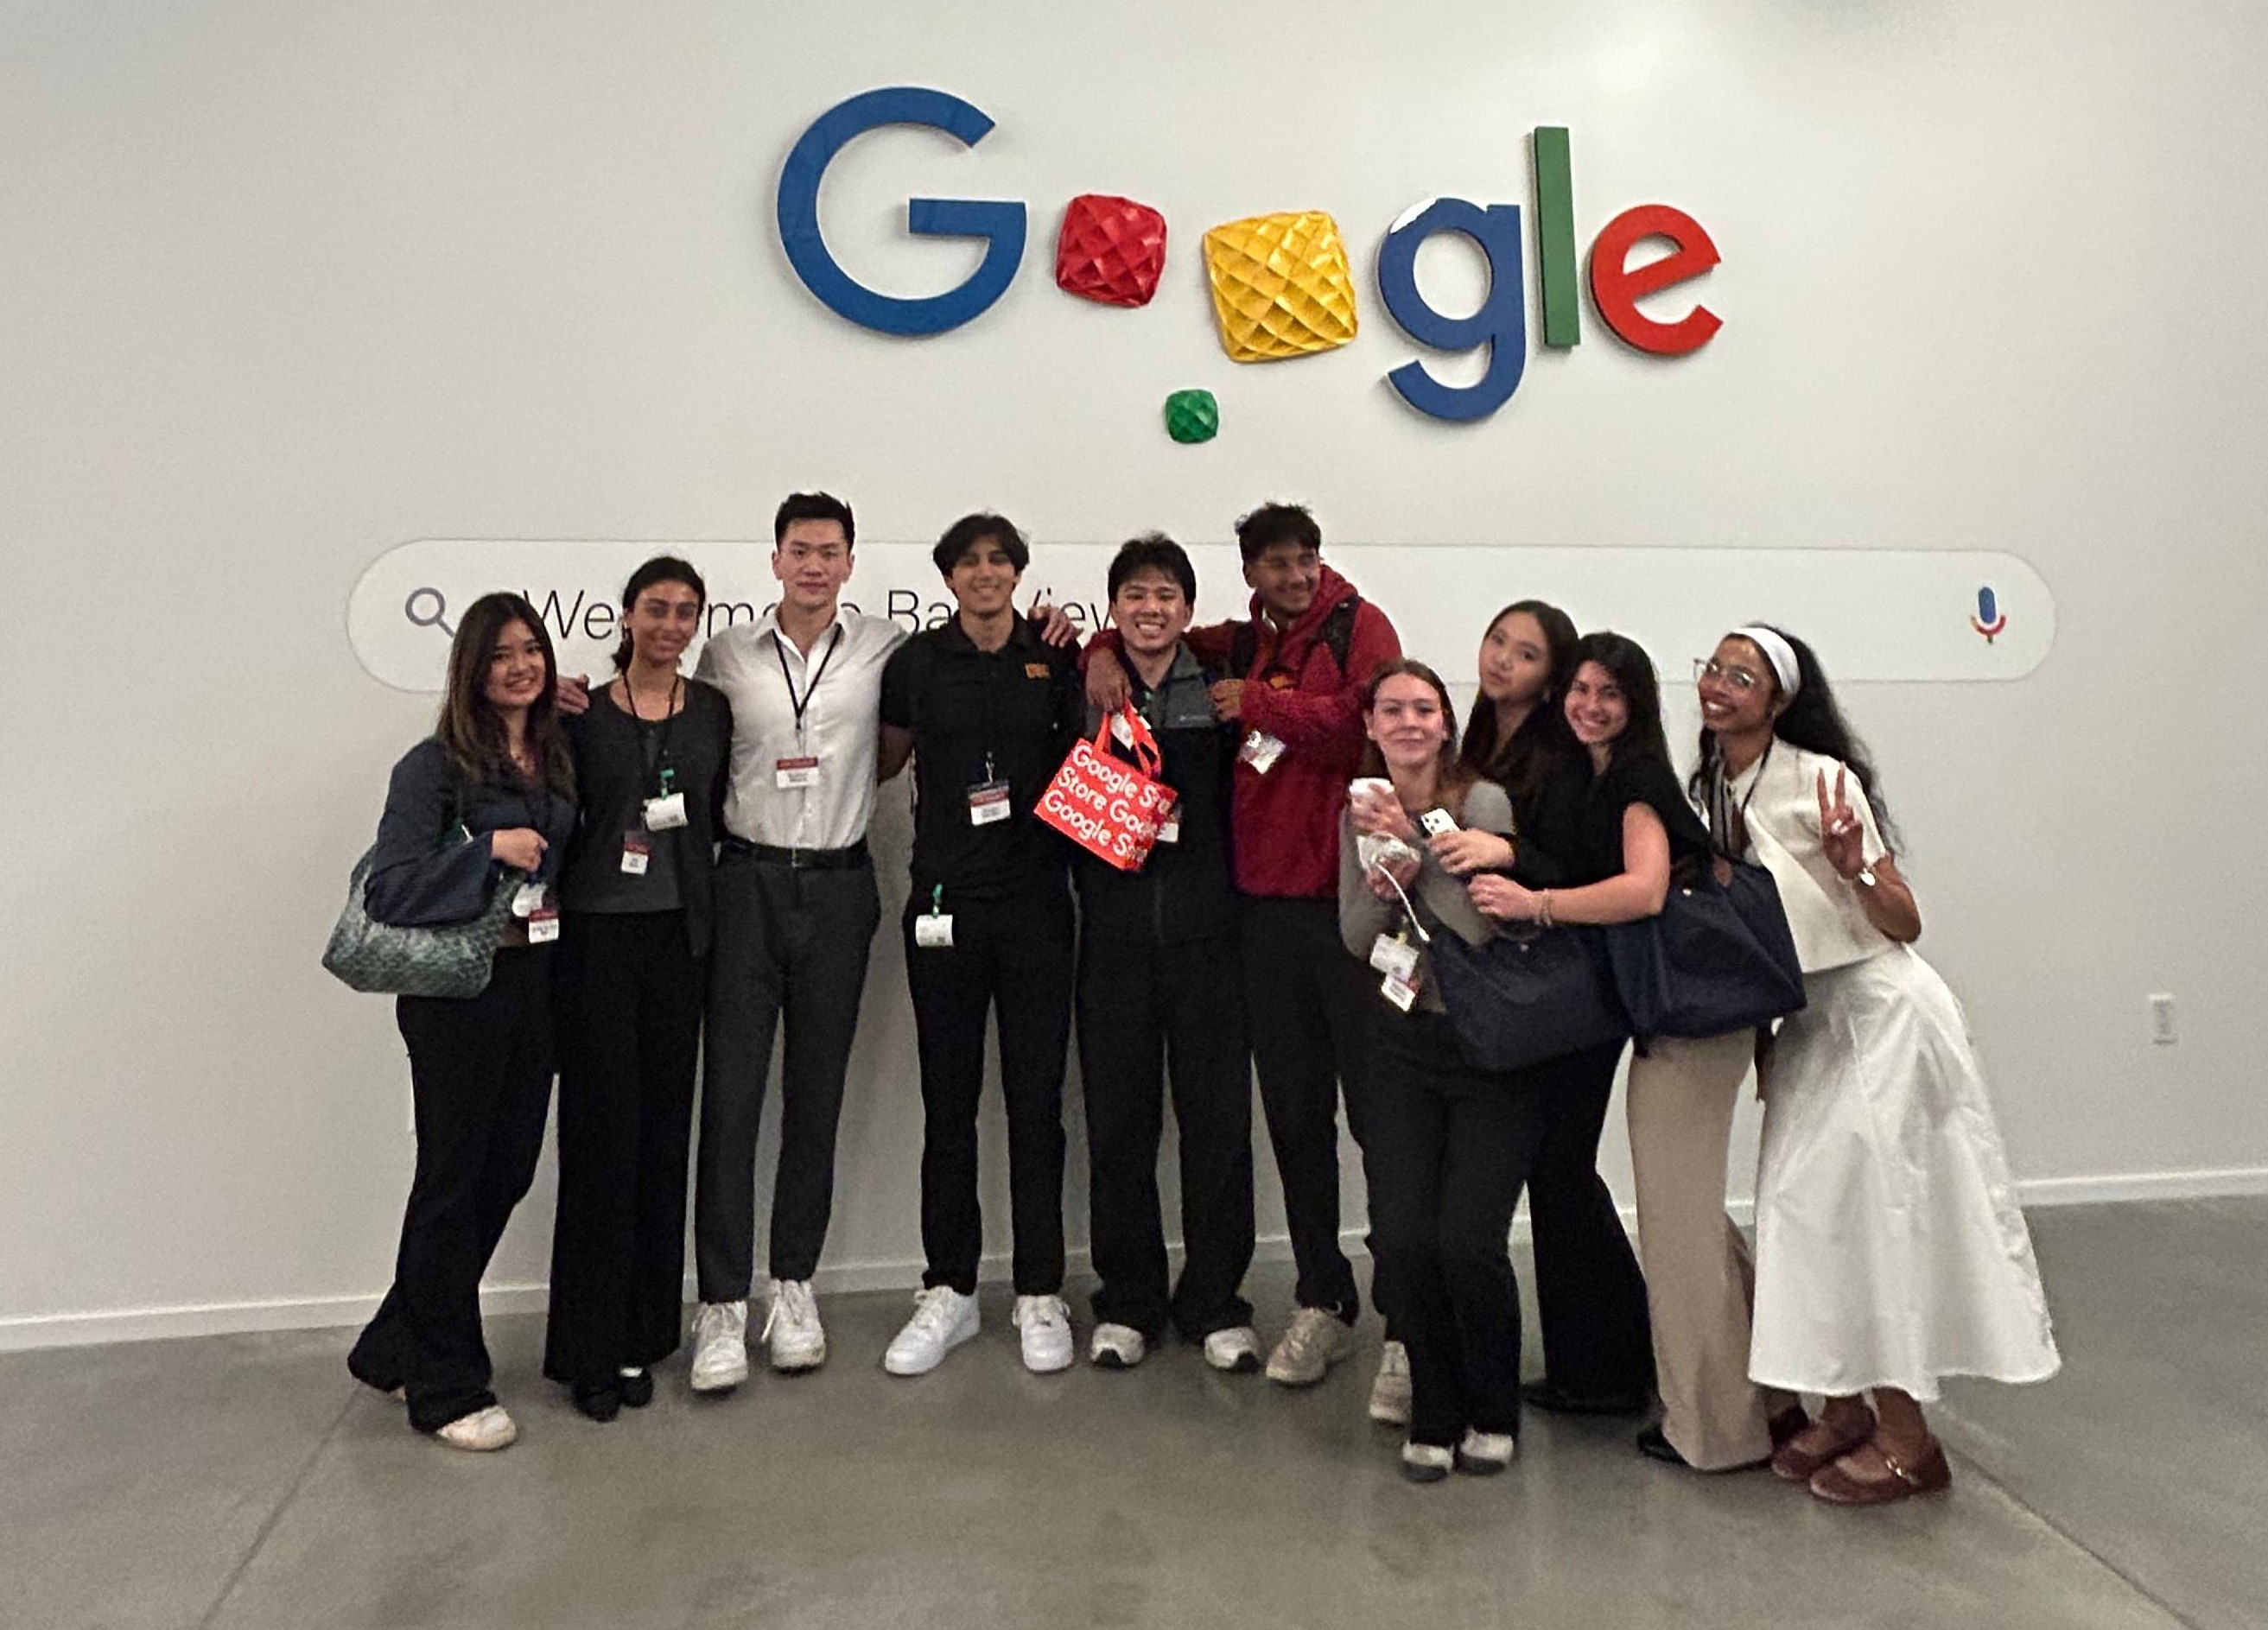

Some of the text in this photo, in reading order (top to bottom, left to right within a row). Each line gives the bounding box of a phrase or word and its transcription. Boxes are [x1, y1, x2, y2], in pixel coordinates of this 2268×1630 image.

[777, 86, 1723, 422] Ggle
[888, 589, 951, 632] Ba
[1057, 765, 1108, 811] Store
[1072, 745, 1138, 799] Google
[1045, 789, 1112, 846] Google
